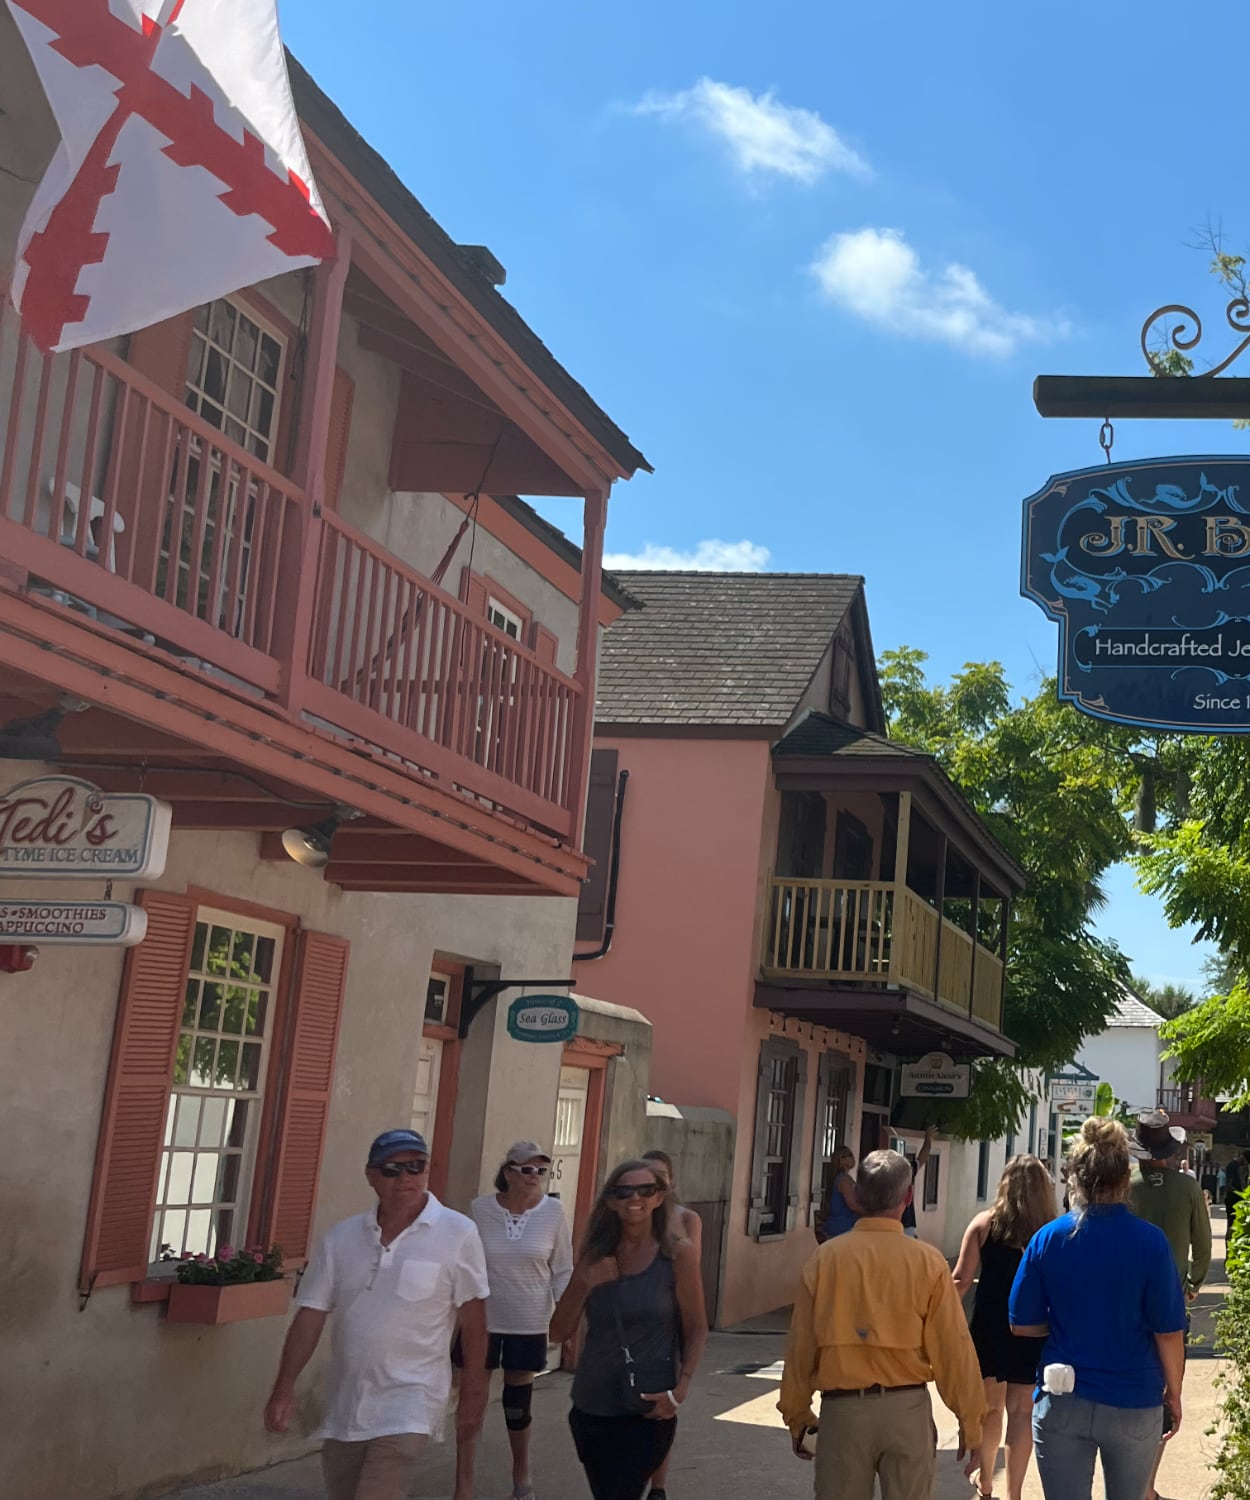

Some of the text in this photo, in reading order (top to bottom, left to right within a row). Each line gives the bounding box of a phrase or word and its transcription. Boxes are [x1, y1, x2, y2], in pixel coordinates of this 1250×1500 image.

[1079, 515, 1195, 560] J.R.
[1095, 633, 1223, 658] Handcrafted
[1193, 693, 1241, 711] Since
[3, 847, 139, 864] TYME ICE CREAM
[18, 907, 107, 921] SMOOTHIES
[519, 1012, 567, 1025] Sea Glass
